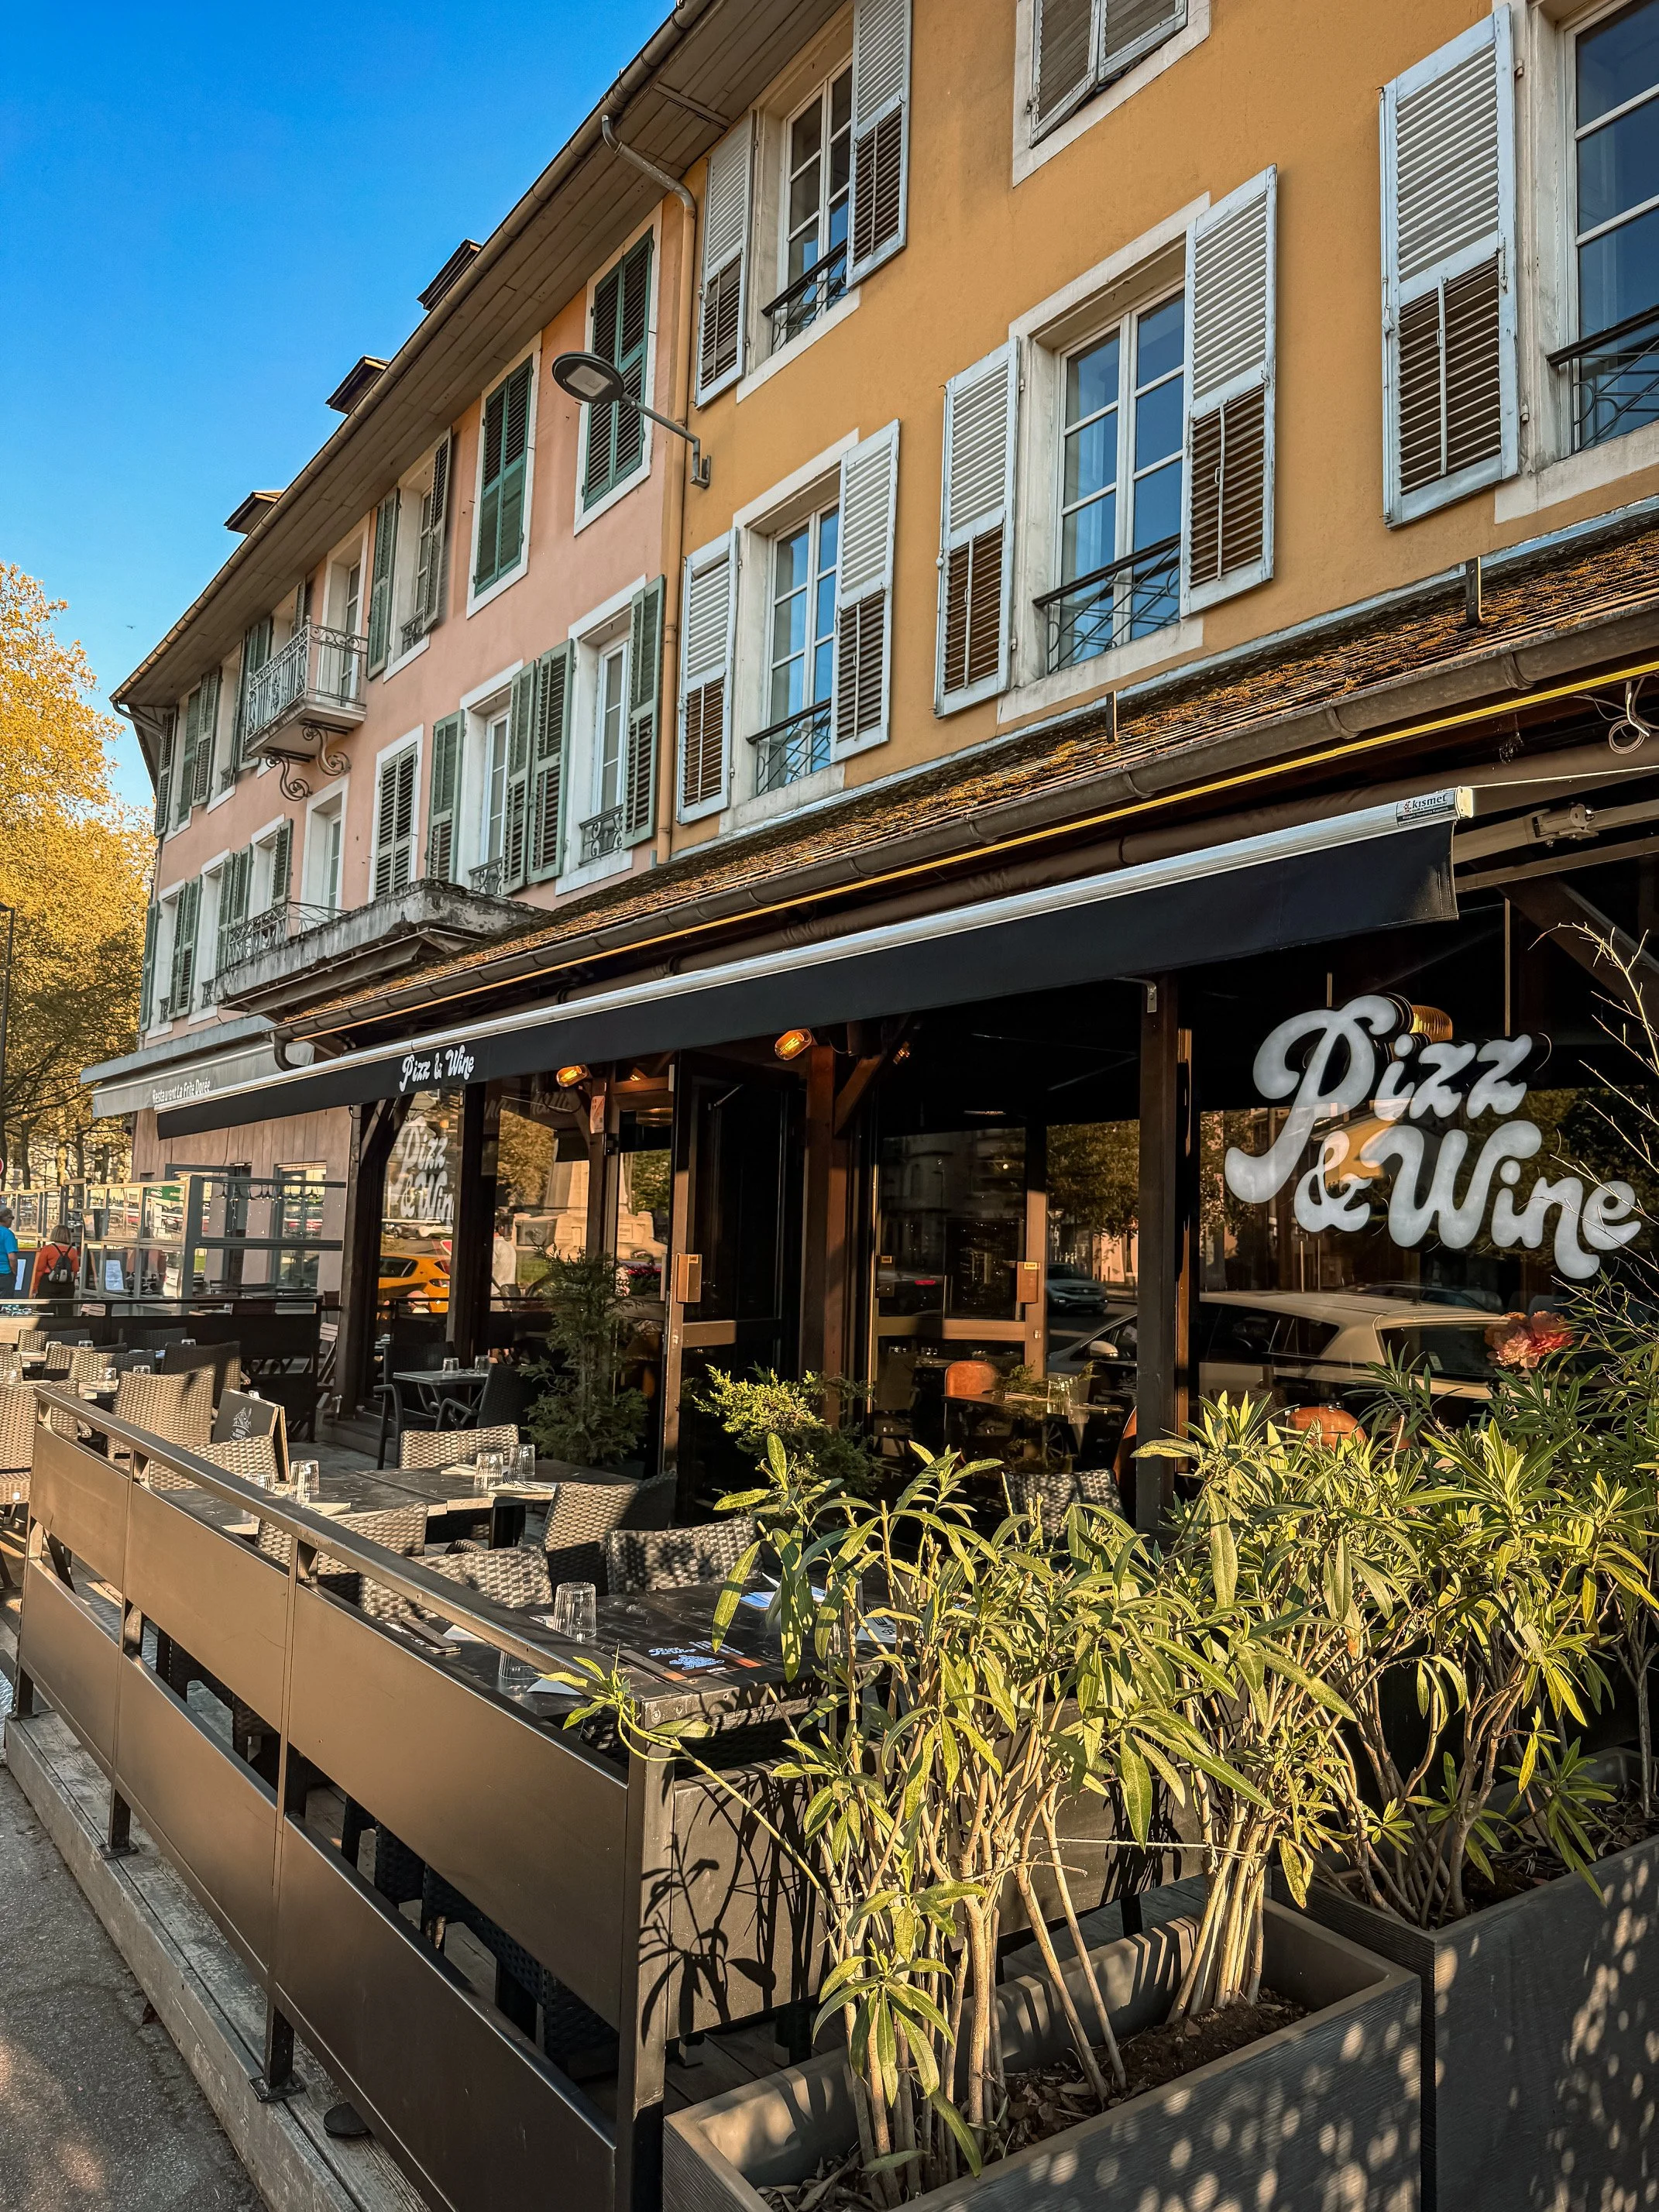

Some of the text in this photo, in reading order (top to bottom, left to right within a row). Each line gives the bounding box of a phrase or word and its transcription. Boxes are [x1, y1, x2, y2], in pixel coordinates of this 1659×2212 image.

[153, 1086, 177, 1104] Restaurant
[177, 1084, 183, 1099] La
[195, 1077, 211, 1095] Dorée
[399, 1045, 474, 1092] Pizz & Wine
[1224, 994, 1533, 1204] Pizz
[388, 1115, 448, 1206] Pizz
[400, 1170, 455, 1226] & Win
[1293, 1120, 1642, 1279] & Wine
